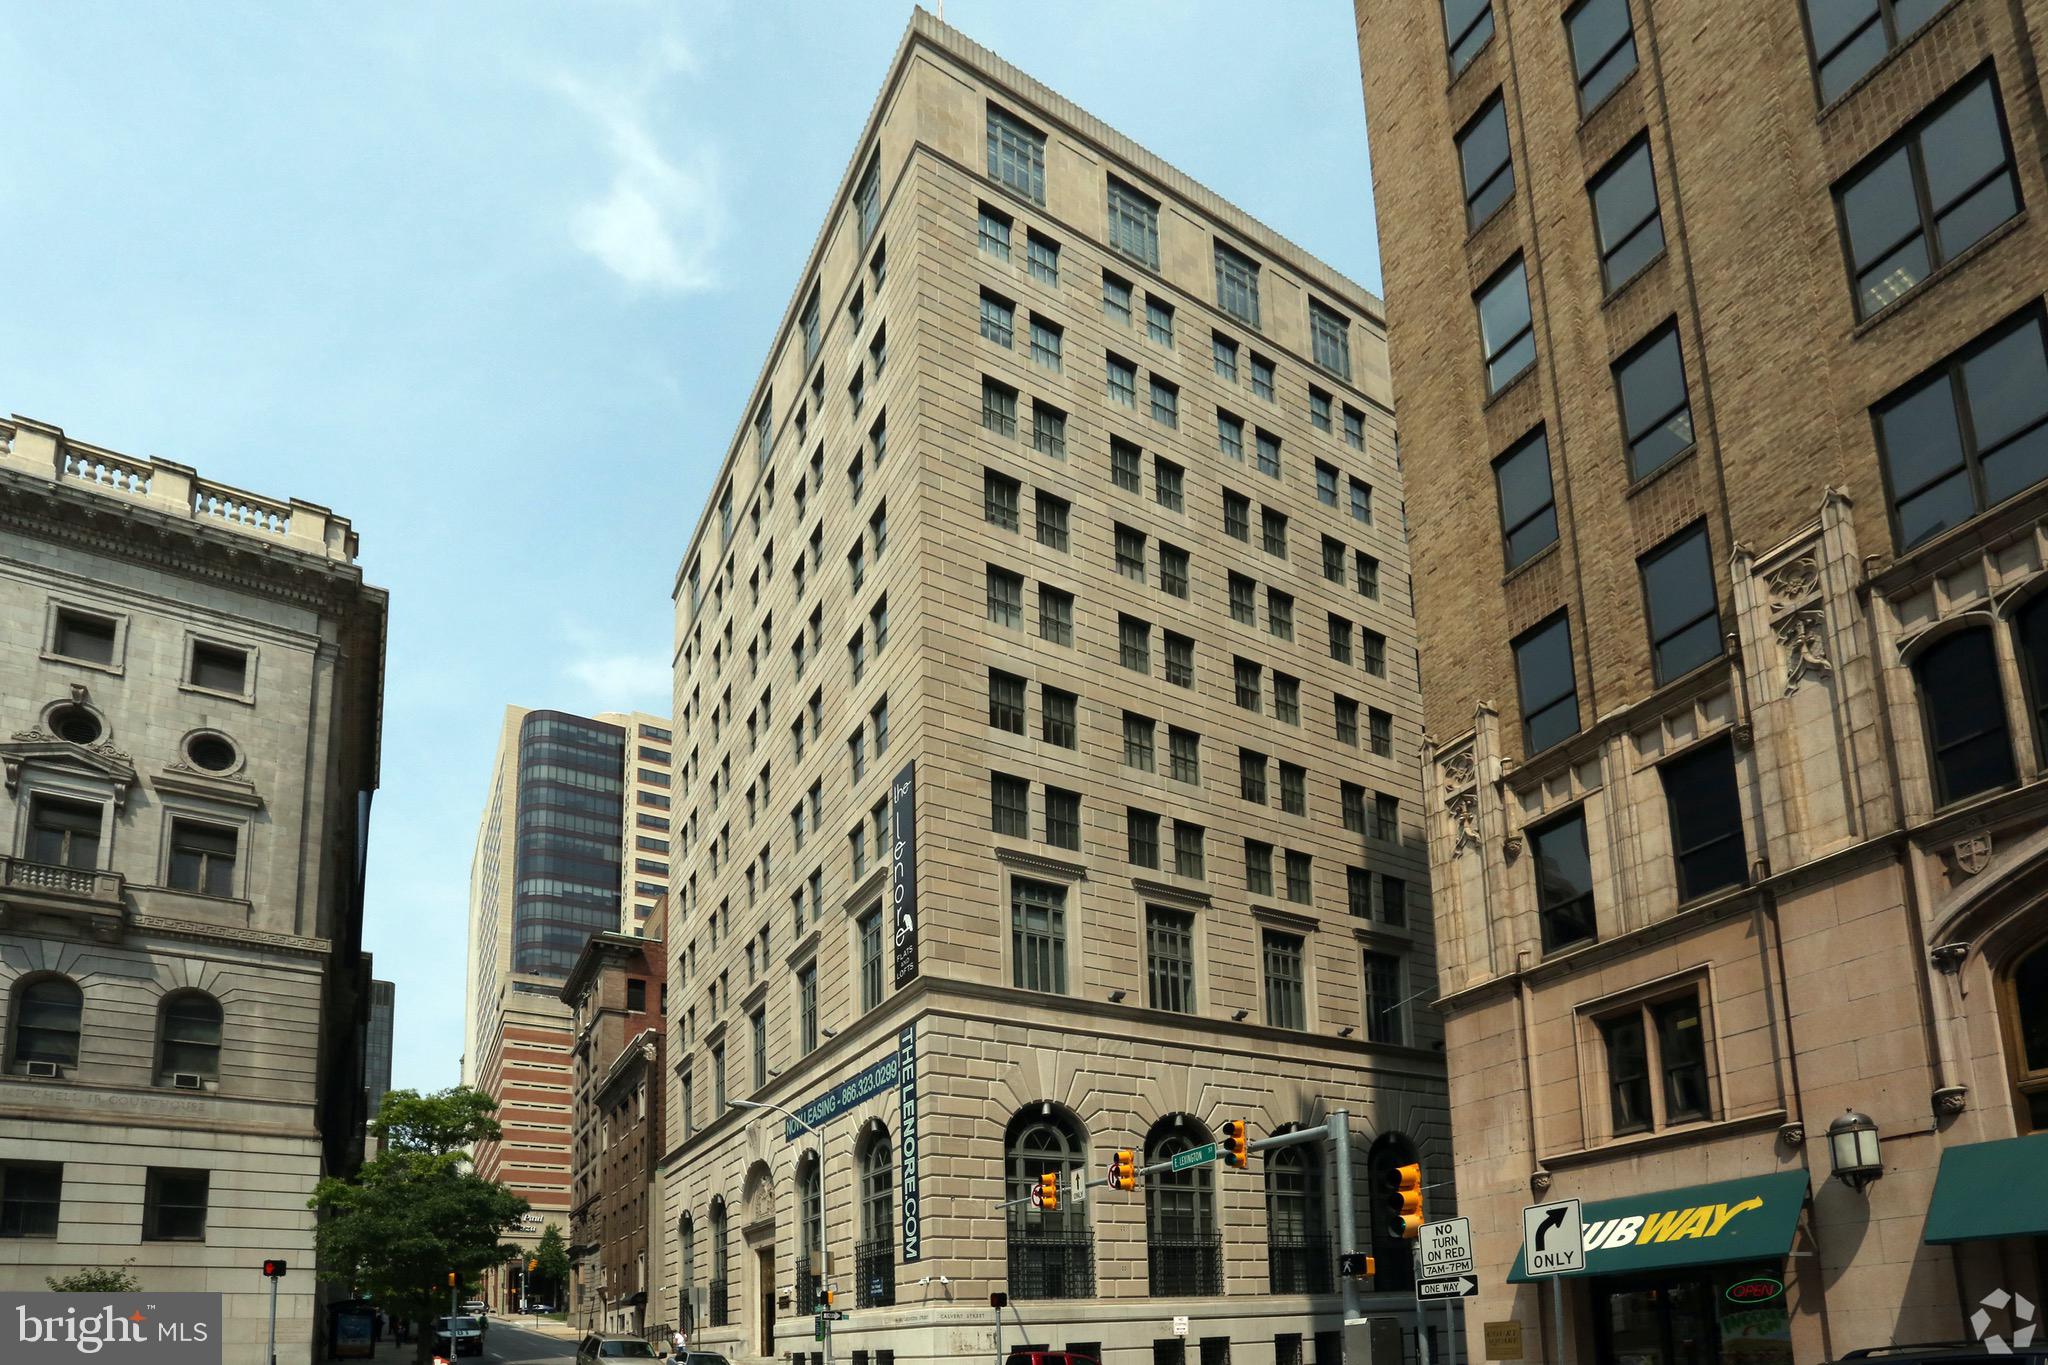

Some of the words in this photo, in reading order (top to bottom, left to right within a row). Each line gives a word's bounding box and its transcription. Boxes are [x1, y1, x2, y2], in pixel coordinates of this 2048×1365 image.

[894, 811, 909, 946] lenore
[897, 962, 913, 979] LOFTS
[902, 1027, 913, 1084] THE
[803, 1095, 836, 1125] LEASING
[842, 1060, 897, 1106] 866.323.0299
[903, 1083, 917, 1258] LENORE.COM
[1435, 1224, 1452, 1236] NO
[1432, 1235, 1458, 1248] TURN
[1427, 1251, 1442, 1262] ON
[1445, 1247, 1465, 1259] RED
[1534, 1250, 1574, 1269] ONLY
[1425, 1261, 1470, 1275] 7AM-7PM
[1424, 1284, 1440, 1293] ONE
[1443, 1282, 1459, 1292] WAY
[1733, 1284, 1774, 1297] OPEN
